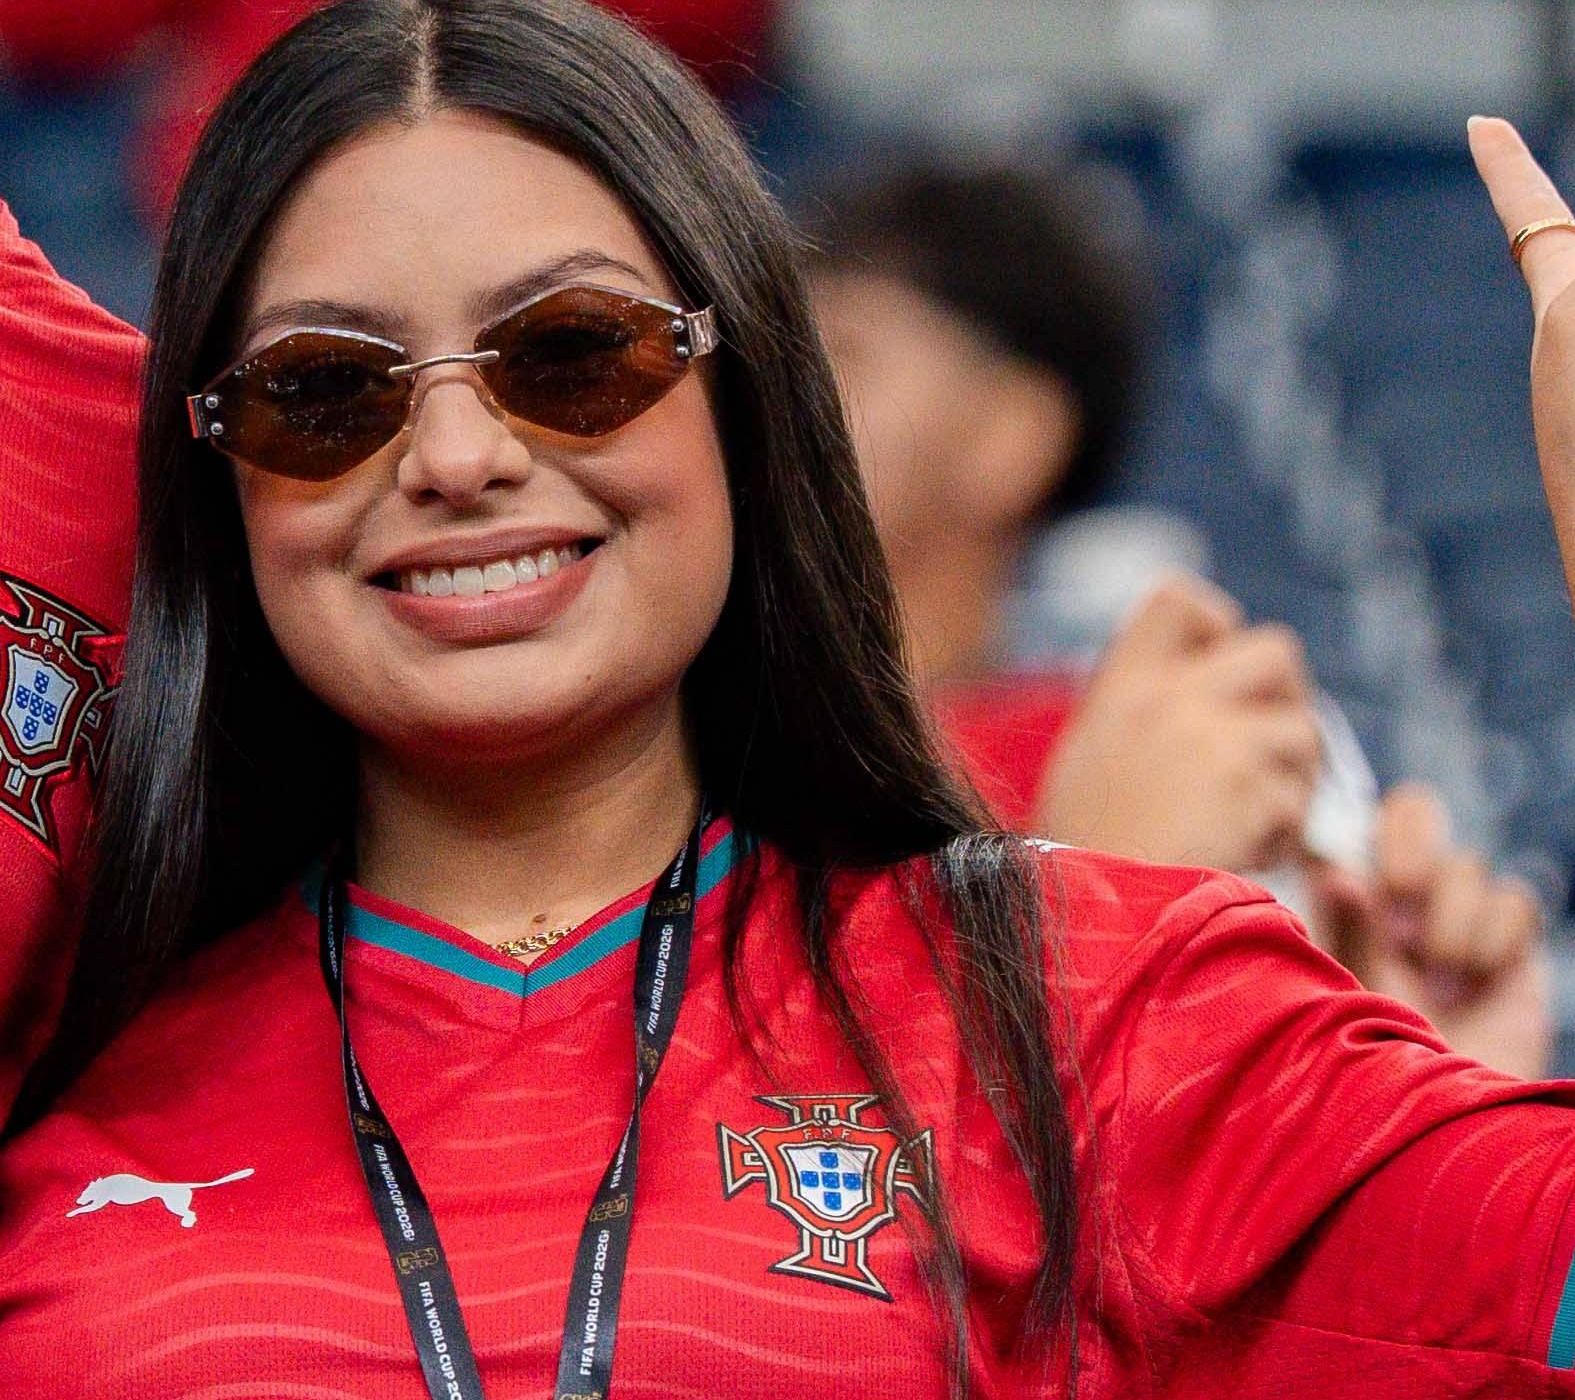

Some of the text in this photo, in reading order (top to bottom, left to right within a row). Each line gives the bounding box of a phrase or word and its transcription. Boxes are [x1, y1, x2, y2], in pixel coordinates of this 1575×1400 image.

[656, 960, 668, 979] CUP
[650, 979, 665, 1011] WORLD
[647, 1011, 660, 1034] FIFA
[380, 1163, 399, 1189] WORLD
[389, 1189, 405, 1207] CUP
[419, 1281, 434, 1307] FIFA
[589, 1272, 603, 1297] CUP
[426, 1307, 447, 1353] WORLD
[584, 1298, 600, 1344] WORLD
[439, 1354, 455, 1380] CUP
[580, 1346, 595, 1376] FIFA
